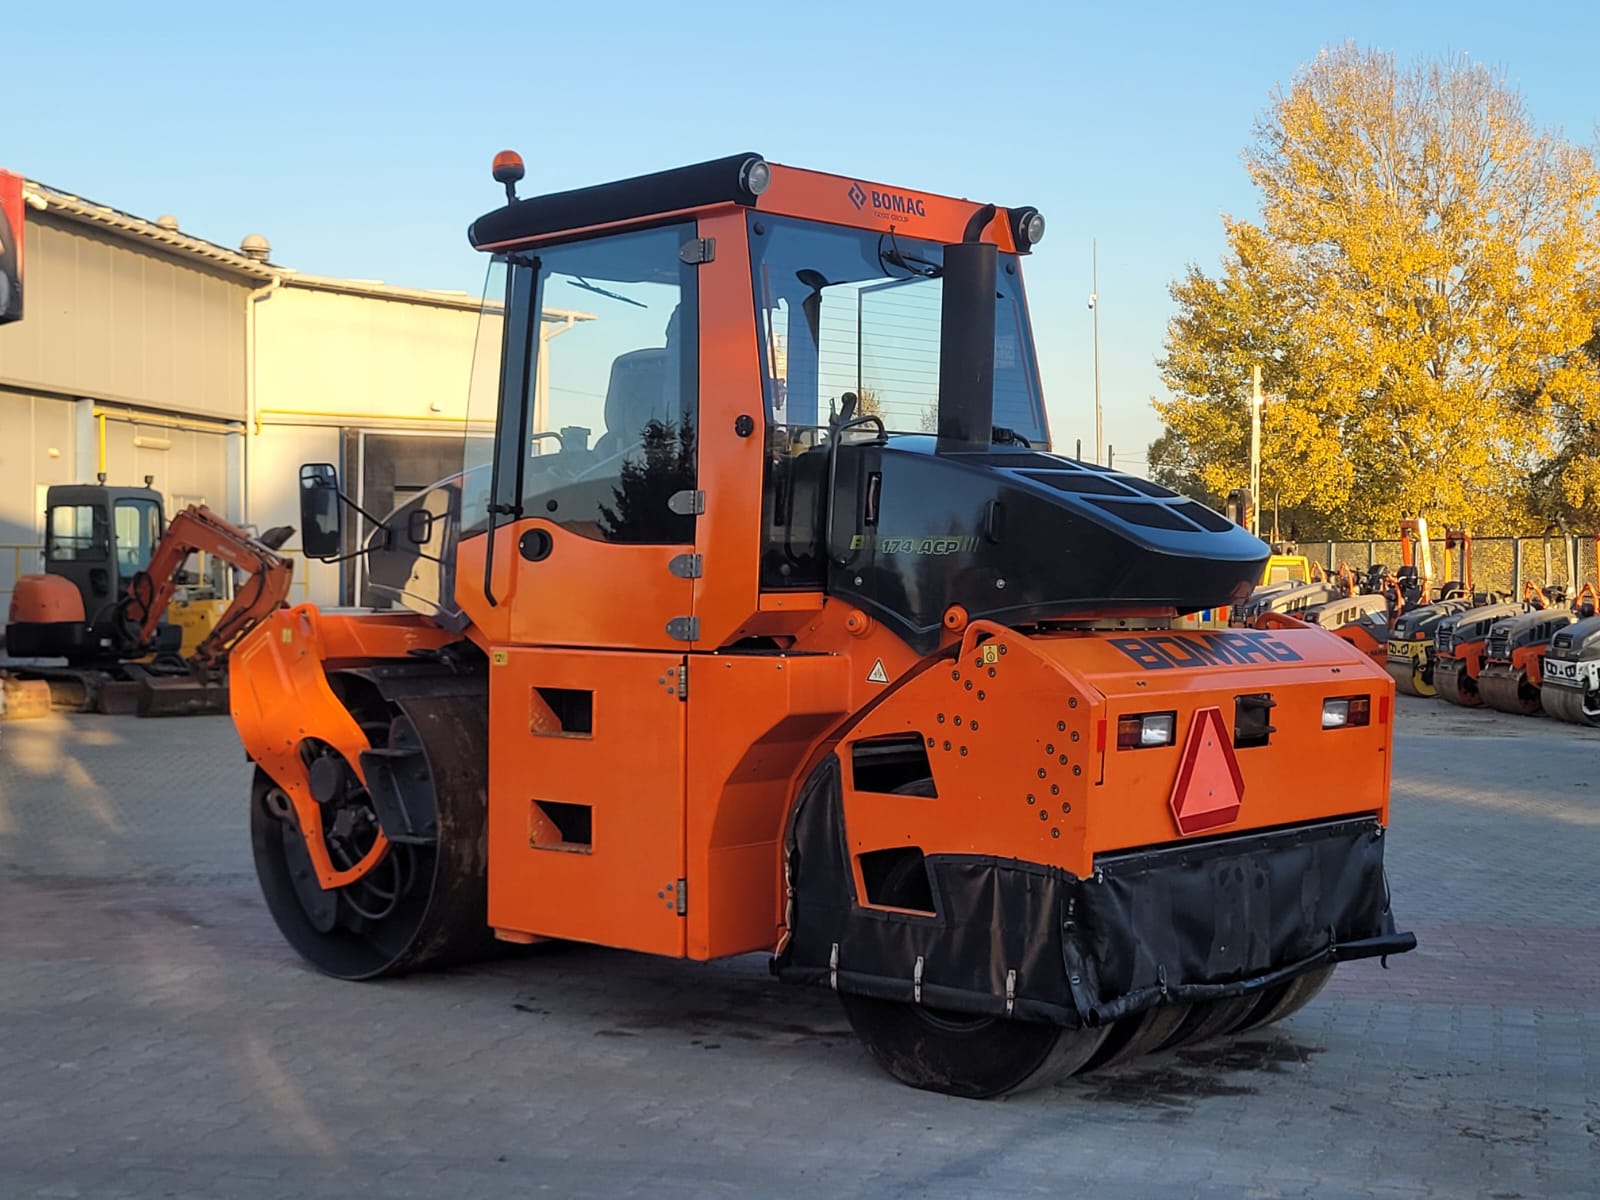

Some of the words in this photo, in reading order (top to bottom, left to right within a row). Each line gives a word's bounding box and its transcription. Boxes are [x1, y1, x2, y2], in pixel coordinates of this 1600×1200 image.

[871, 190, 926, 217] BOMAG
[882, 539, 913, 554] 174
[917, 540, 960, 555] ACP
[1106, 632, 1304, 670] BOMAG
